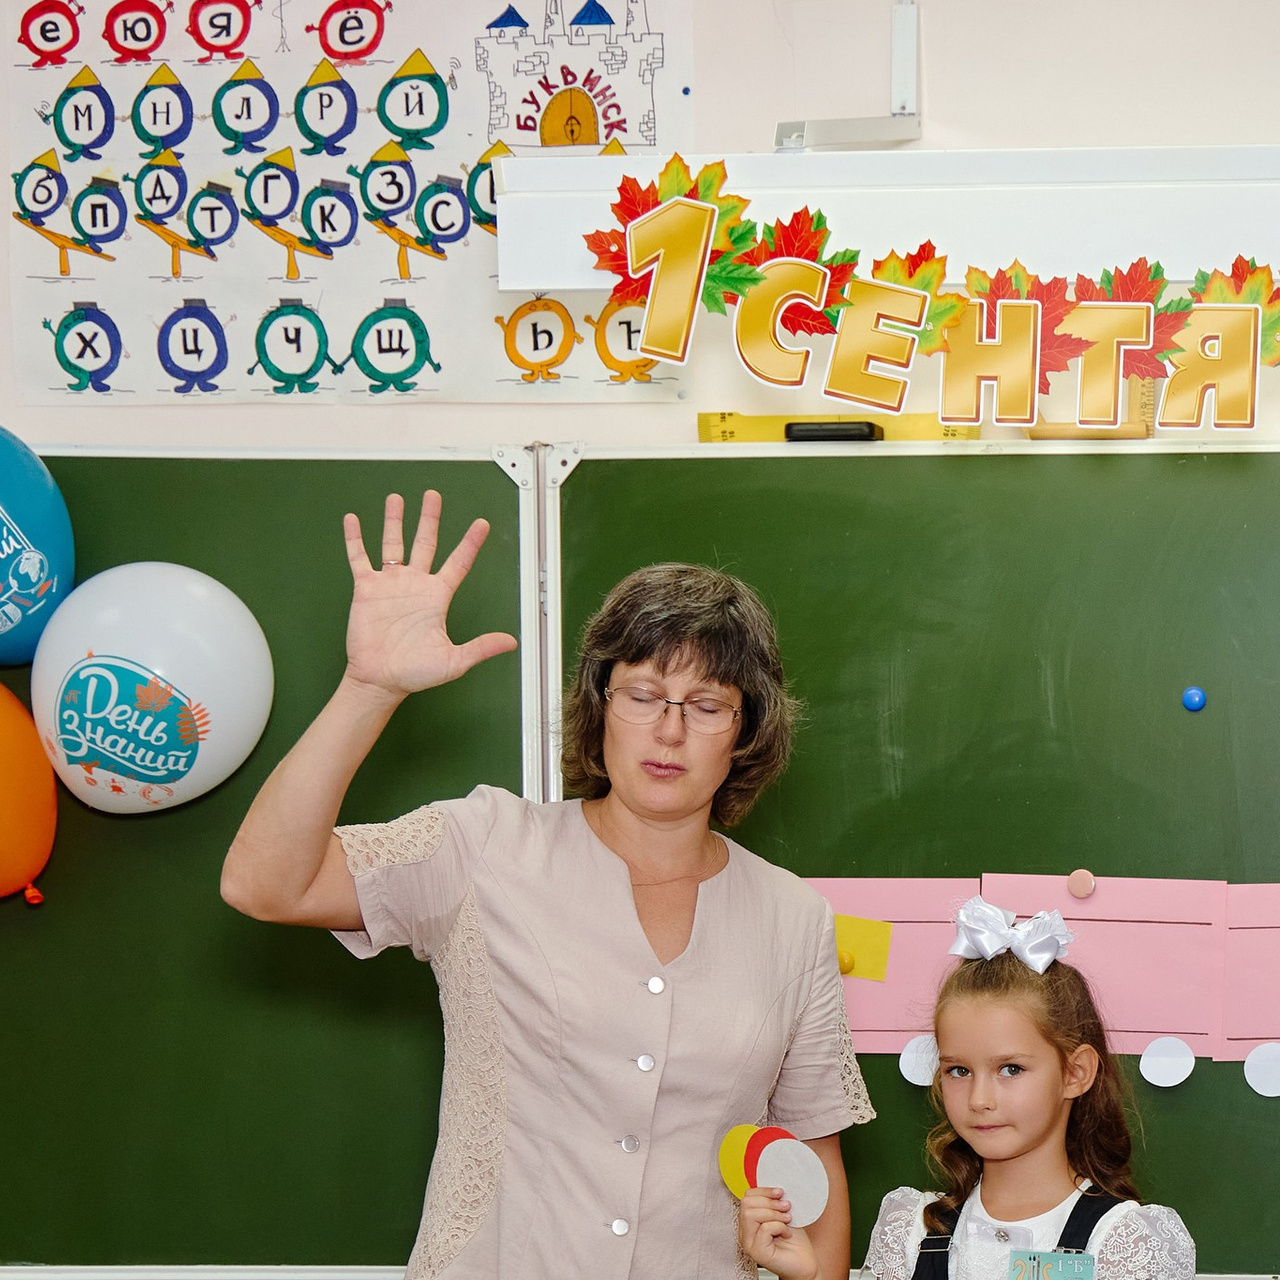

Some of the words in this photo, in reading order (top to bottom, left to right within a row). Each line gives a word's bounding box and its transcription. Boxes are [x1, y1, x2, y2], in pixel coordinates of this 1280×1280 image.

[516, 64, 628, 140] БУКВИНСК
[625, 192, 720, 368] 1
[79, 666, 168, 746] День
